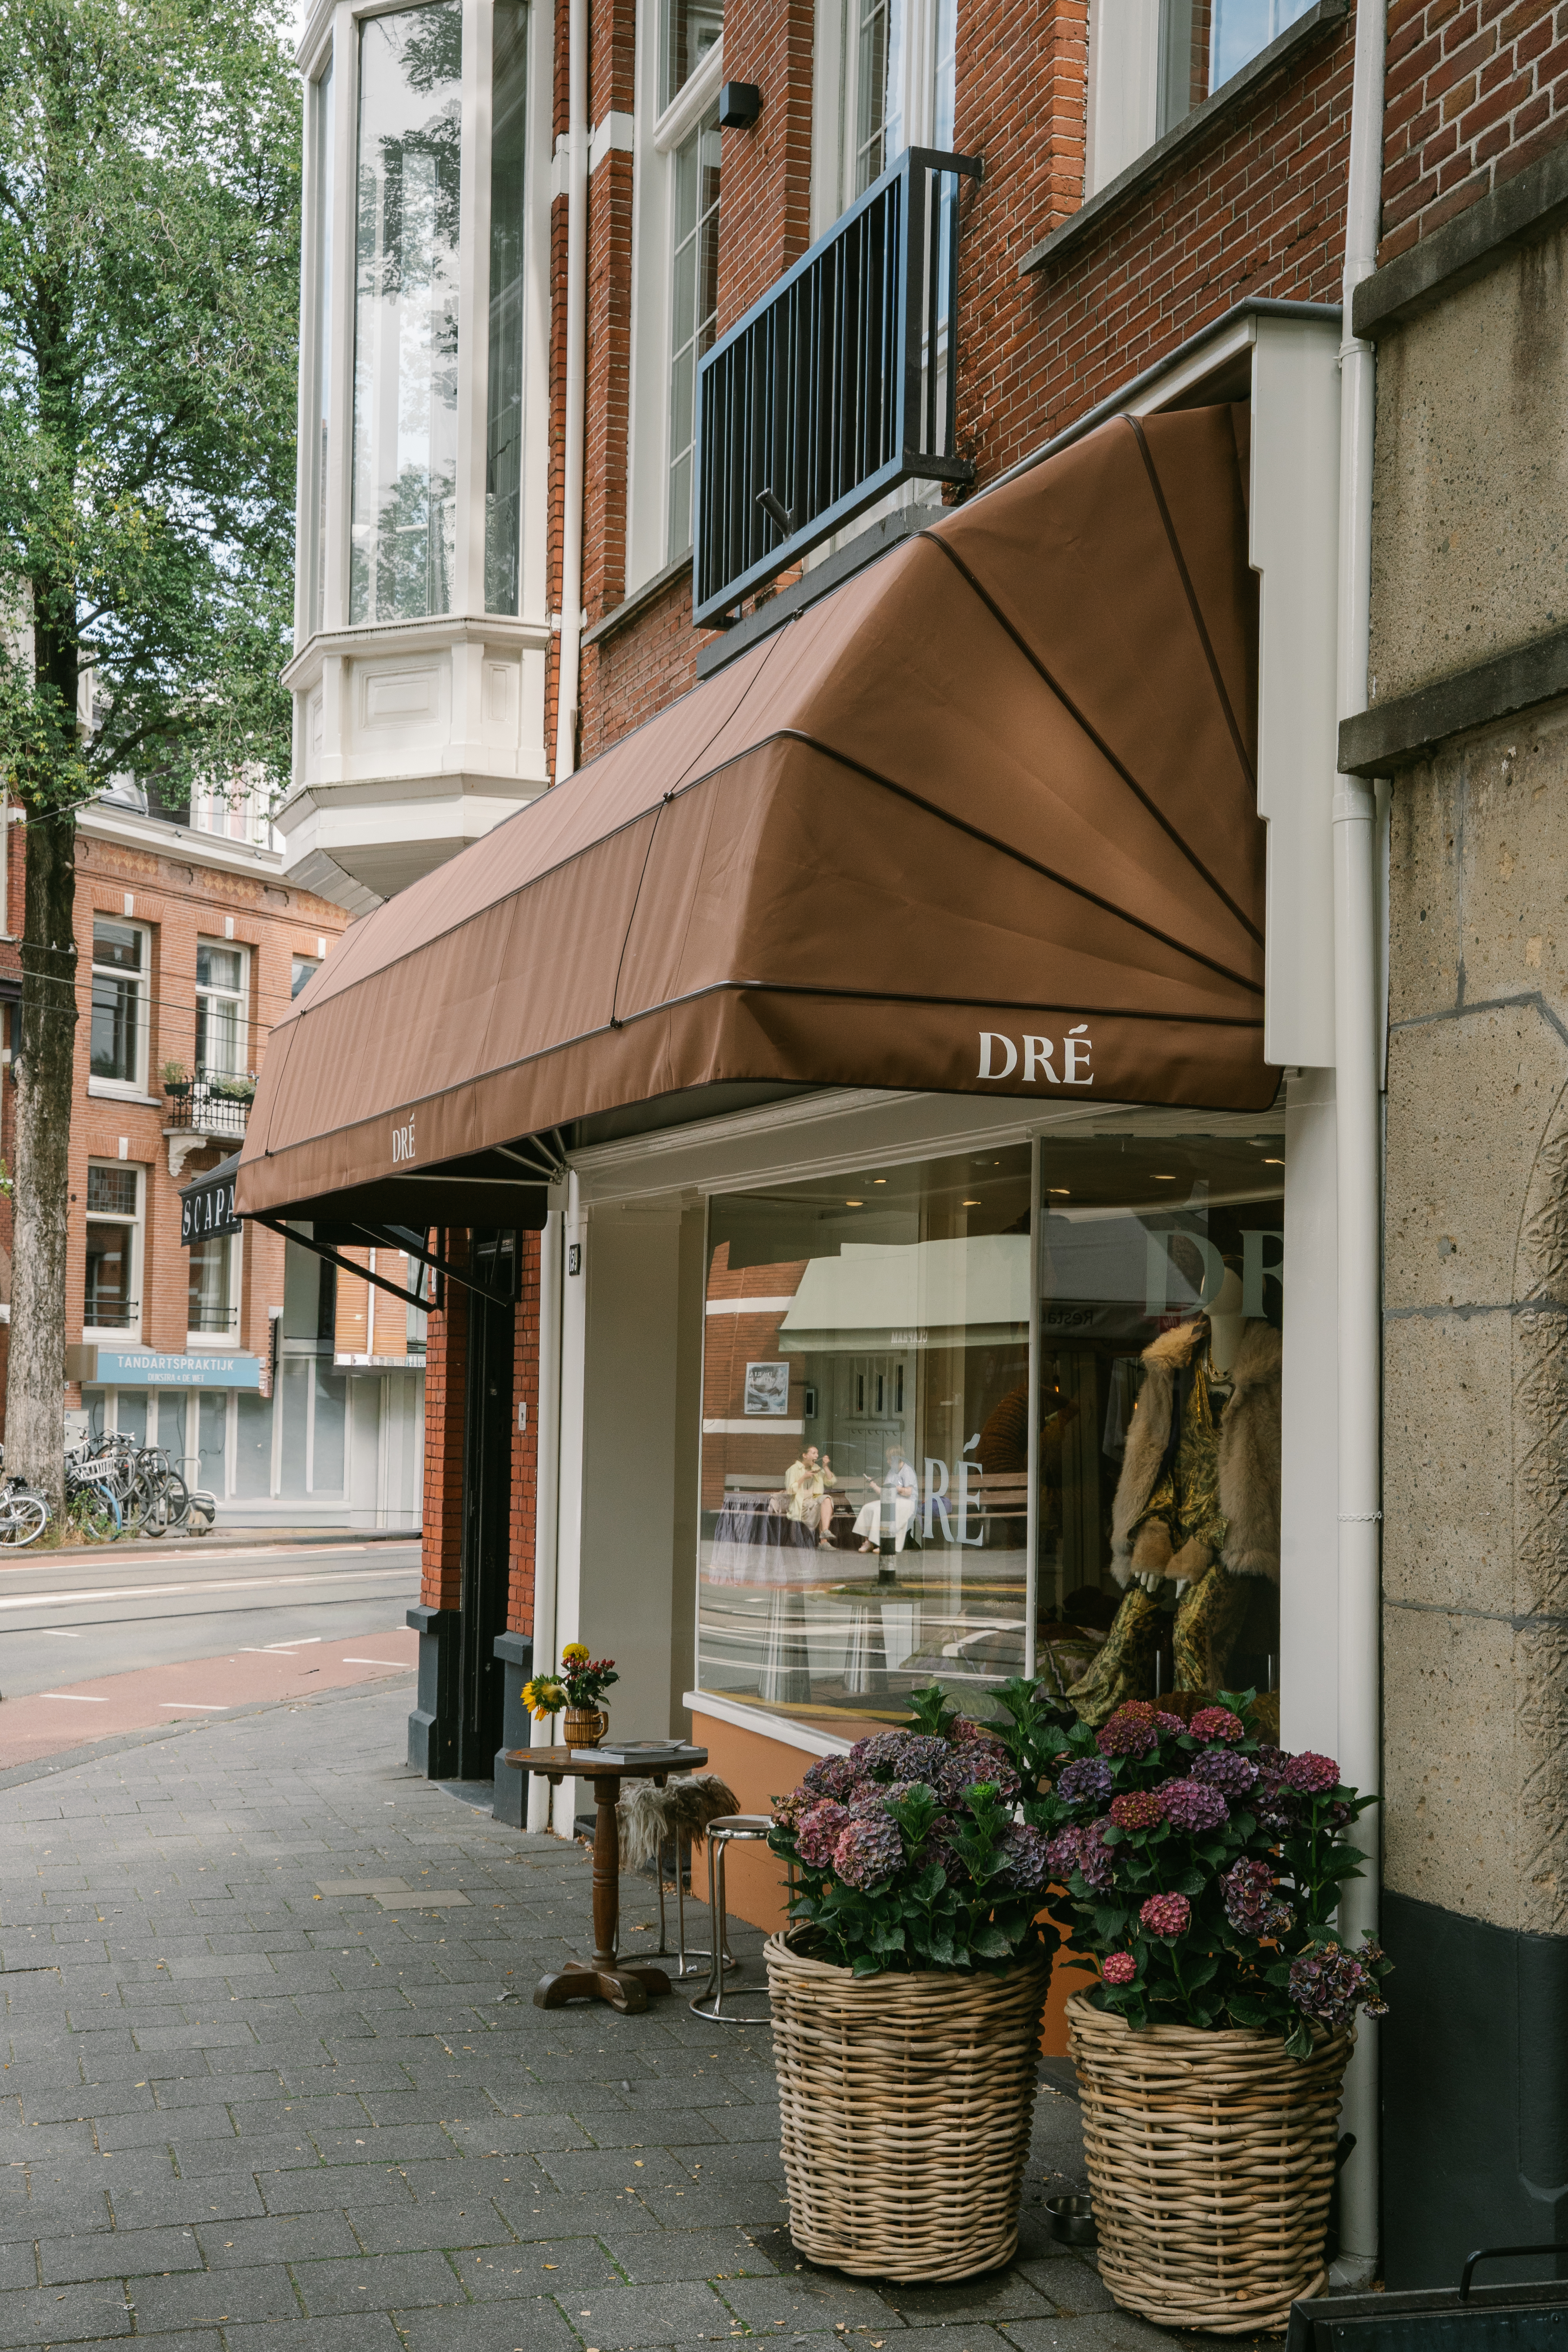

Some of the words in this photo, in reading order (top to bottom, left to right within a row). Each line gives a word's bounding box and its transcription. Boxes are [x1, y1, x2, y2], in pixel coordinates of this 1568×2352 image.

[976, 1024, 1094, 1085] DRÉ
[393, 1113, 415, 1163] DRÉ
[183, 1185, 237, 1236] SCAPA
[118, 1356, 234, 1371] TANDARTSPRAKTIJK
